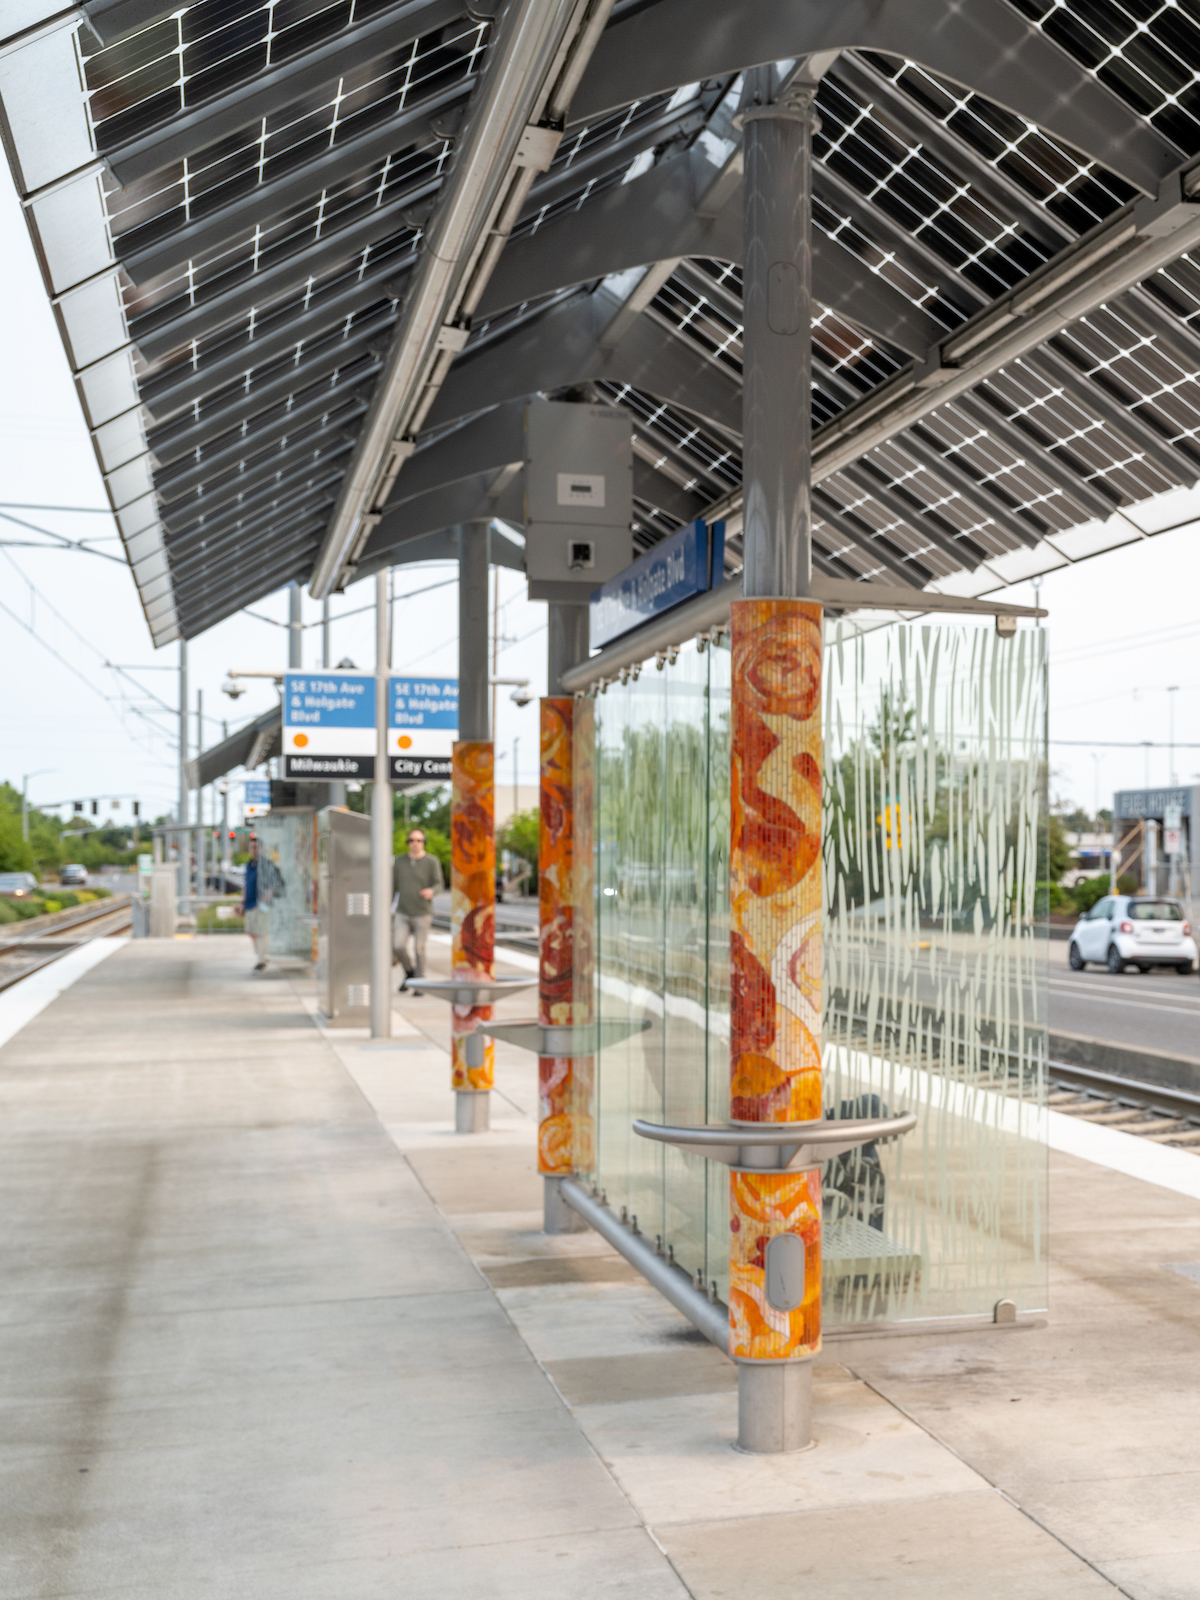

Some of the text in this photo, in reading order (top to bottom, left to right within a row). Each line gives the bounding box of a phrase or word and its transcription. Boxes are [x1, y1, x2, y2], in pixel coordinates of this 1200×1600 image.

[666, 545, 685, 589] Blvd
[291, 680, 365, 695] SE 17th Ave
[395, 682, 459, 697] SE 17th Av
[291, 694, 356, 711] & Holgate
[395, 697, 459, 714] & Holgate
[291, 709, 321, 723] Blvd
[395, 711, 424, 725] Blvd
[291, 758, 360, 773] Milwaukie
[395, 759, 453, 776] City Cent
